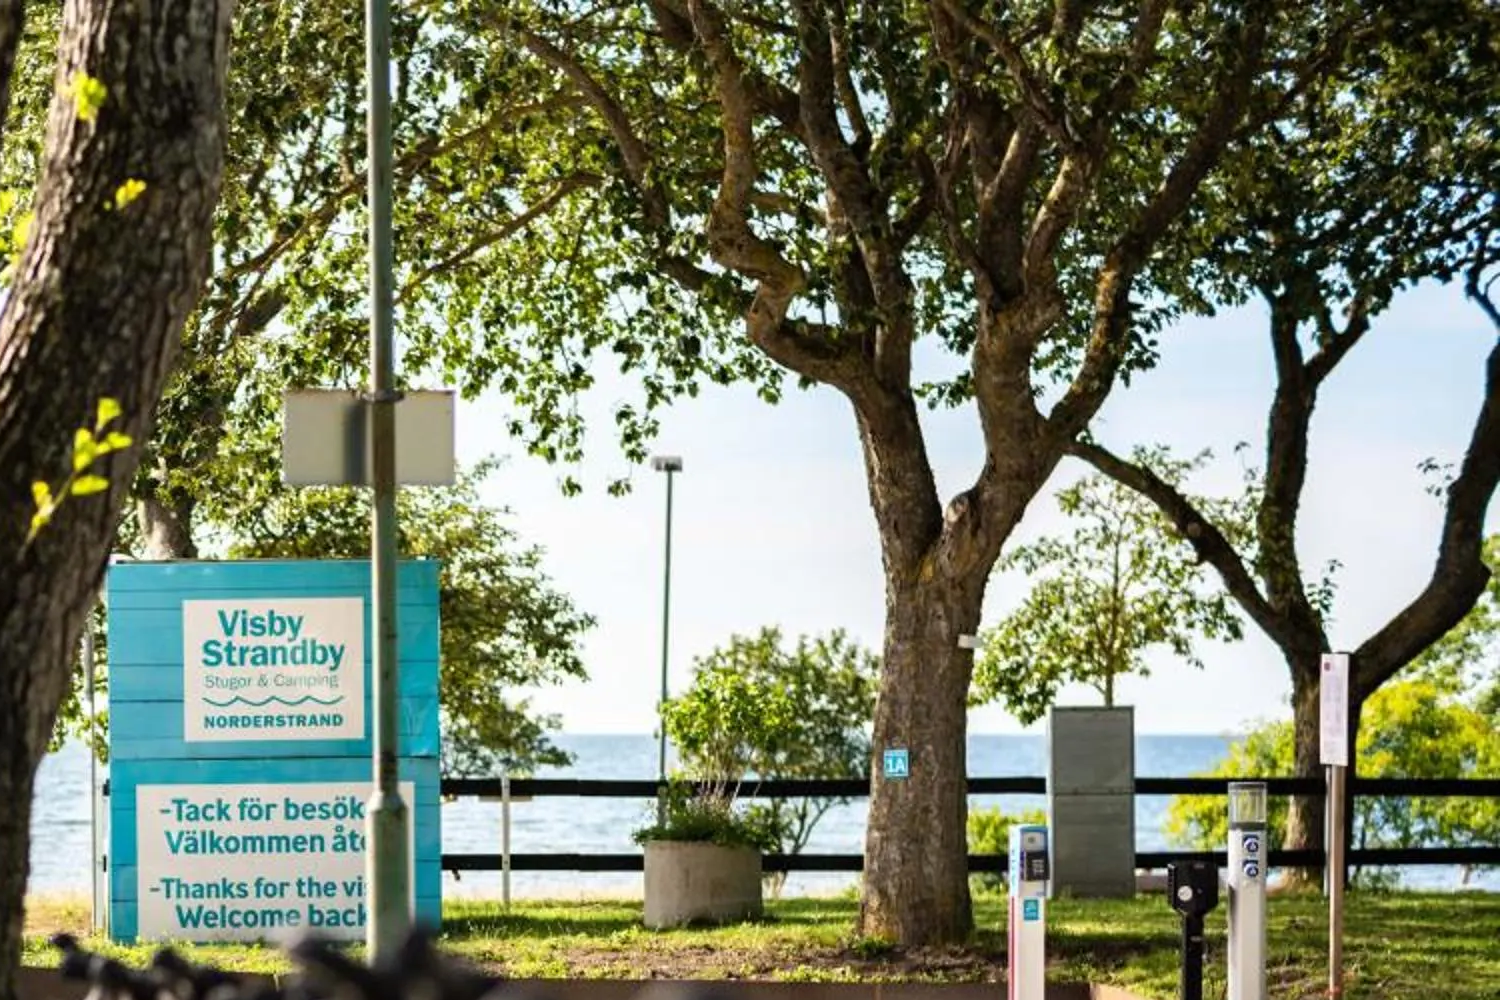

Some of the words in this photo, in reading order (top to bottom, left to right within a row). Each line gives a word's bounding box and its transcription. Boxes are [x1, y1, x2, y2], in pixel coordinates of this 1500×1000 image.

[218, 609, 304, 642] Visby
[202, 639, 345, 671] Strandby
[205, 674, 251, 690] Stugor
[257, 675, 269, 688] &
[273, 673, 339, 689] Camping
[204, 713, 344, 729] NORDERSTRAND
[886, 757, 905, 773] 1A
[238, 796, 277, 821] för
[284, 796, 366, 820] besök
[164, 829, 325, 854] Välkommen
[254, 876, 290, 898] for
[296, 875, 336, 898] the
[342, 875, 367, 897] vi
[176, 904, 301, 928] Welcome
